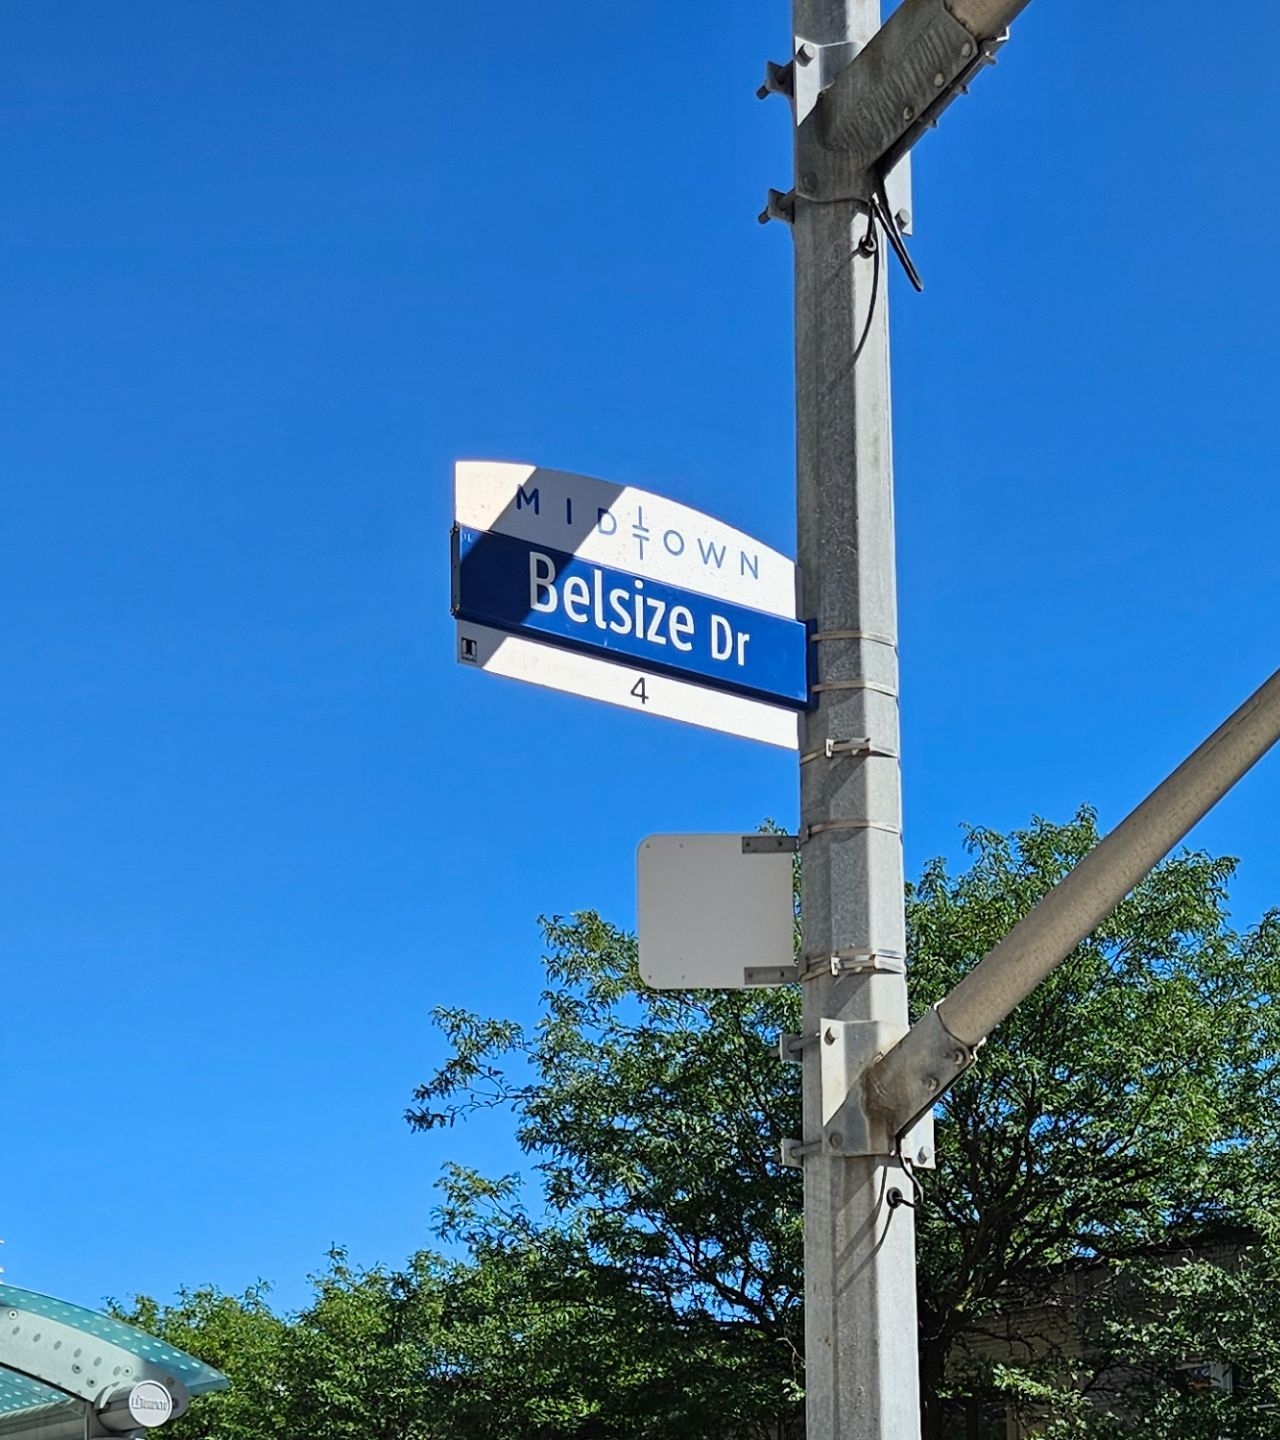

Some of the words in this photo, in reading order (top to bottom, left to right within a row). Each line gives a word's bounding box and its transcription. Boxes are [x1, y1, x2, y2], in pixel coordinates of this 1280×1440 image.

[528, 551, 695, 652] Belsize
[710, 614, 751, 666] Dr
[629, 676, 649, 704] 4
